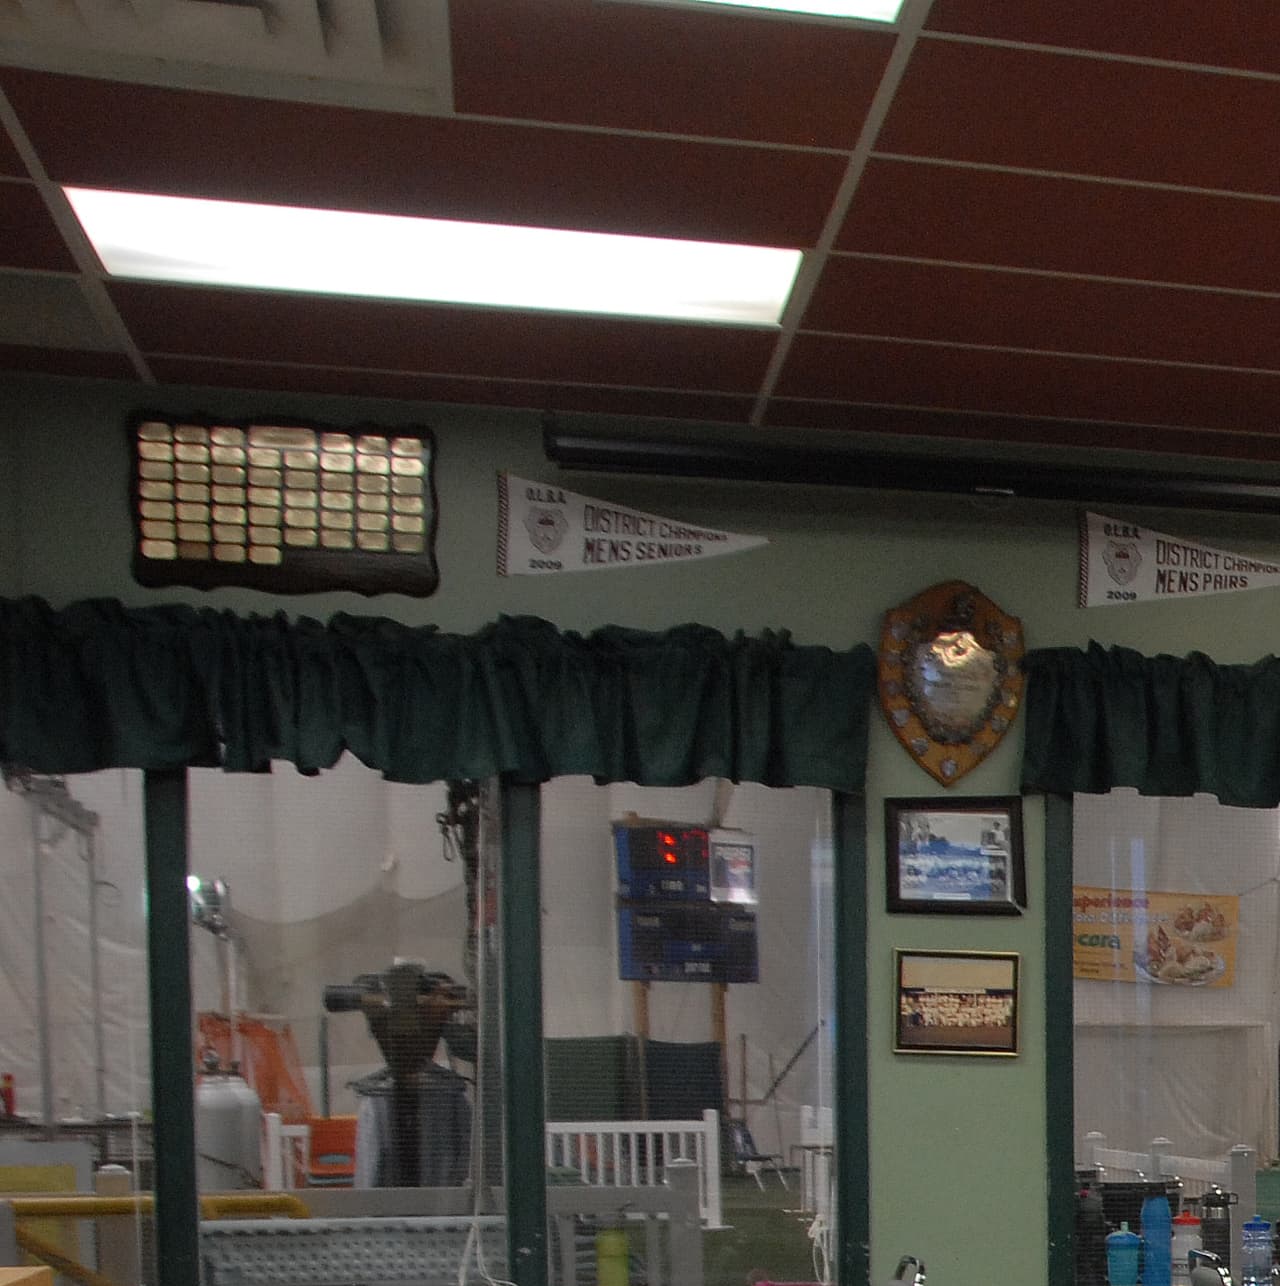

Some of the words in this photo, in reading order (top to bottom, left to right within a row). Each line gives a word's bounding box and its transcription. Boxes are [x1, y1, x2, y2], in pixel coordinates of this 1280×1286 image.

[583, 504, 656, 538] DISTRICT
[659, 522, 729, 542] CHAMPIONS
[583, 537, 631, 564] MENS
[635, 540, 703, 560] SENIORS
[1156, 539, 1221, 570] DISTRICT
[1155, 569, 1199, 593] MENS
[1202, 574, 1248, 590] PAIRS
[1106, 590, 1137, 601] 2009
